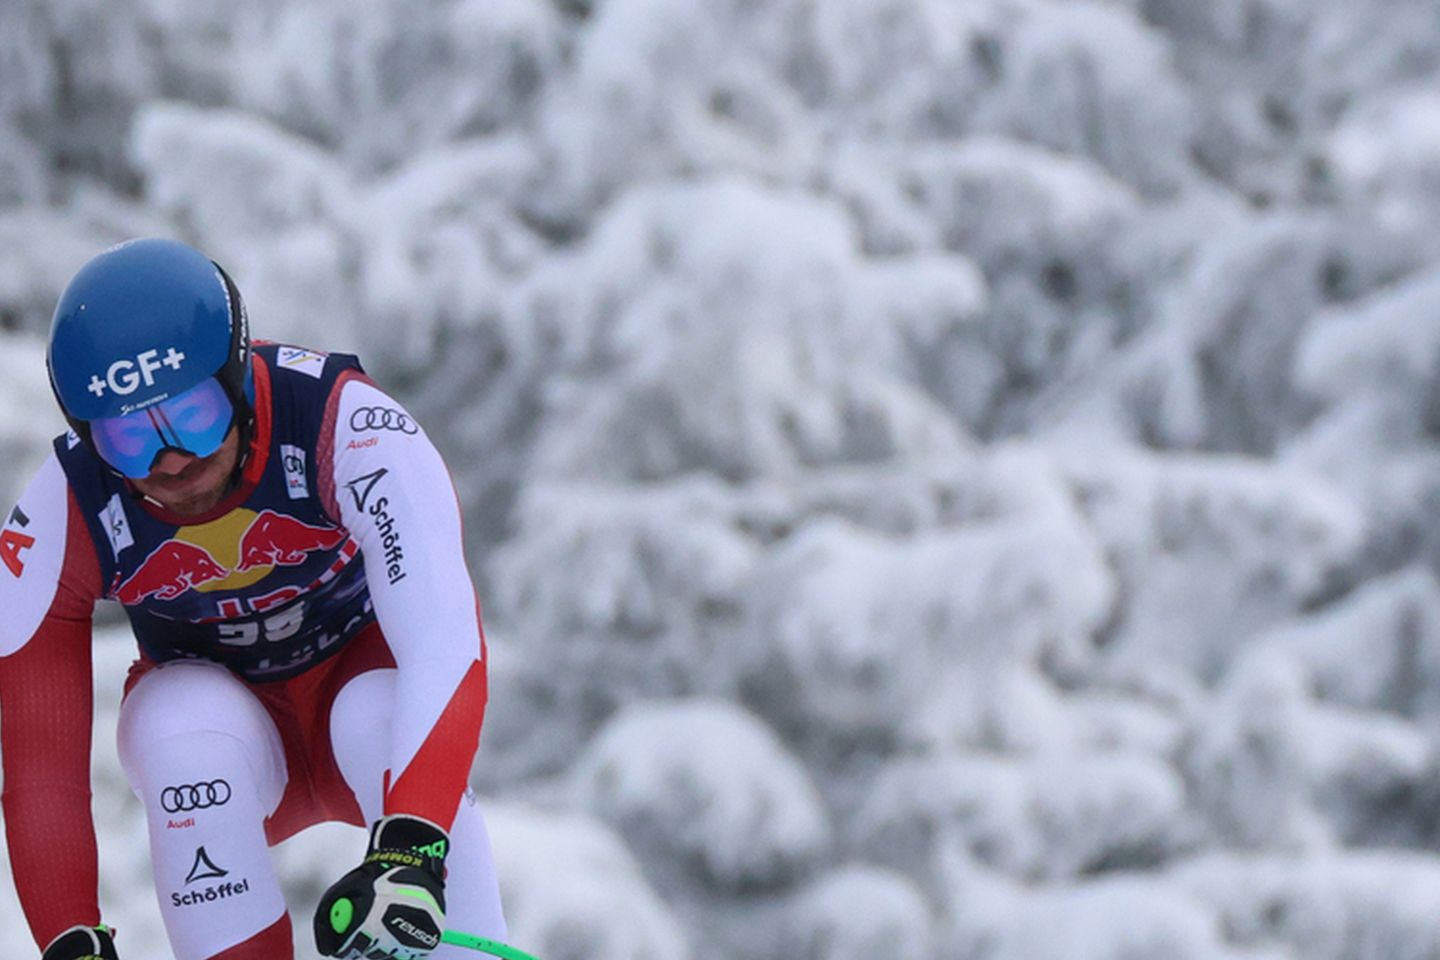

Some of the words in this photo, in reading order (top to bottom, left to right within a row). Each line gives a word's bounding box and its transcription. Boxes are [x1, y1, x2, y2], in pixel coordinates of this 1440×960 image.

[345, 438, 380, 450] Audi
[369, 497, 407, 586] Schöffel
[166, 818, 196, 829] Audi
[171, 878, 250, 907] Schöffel
[391, 917, 438, 947] reusch
